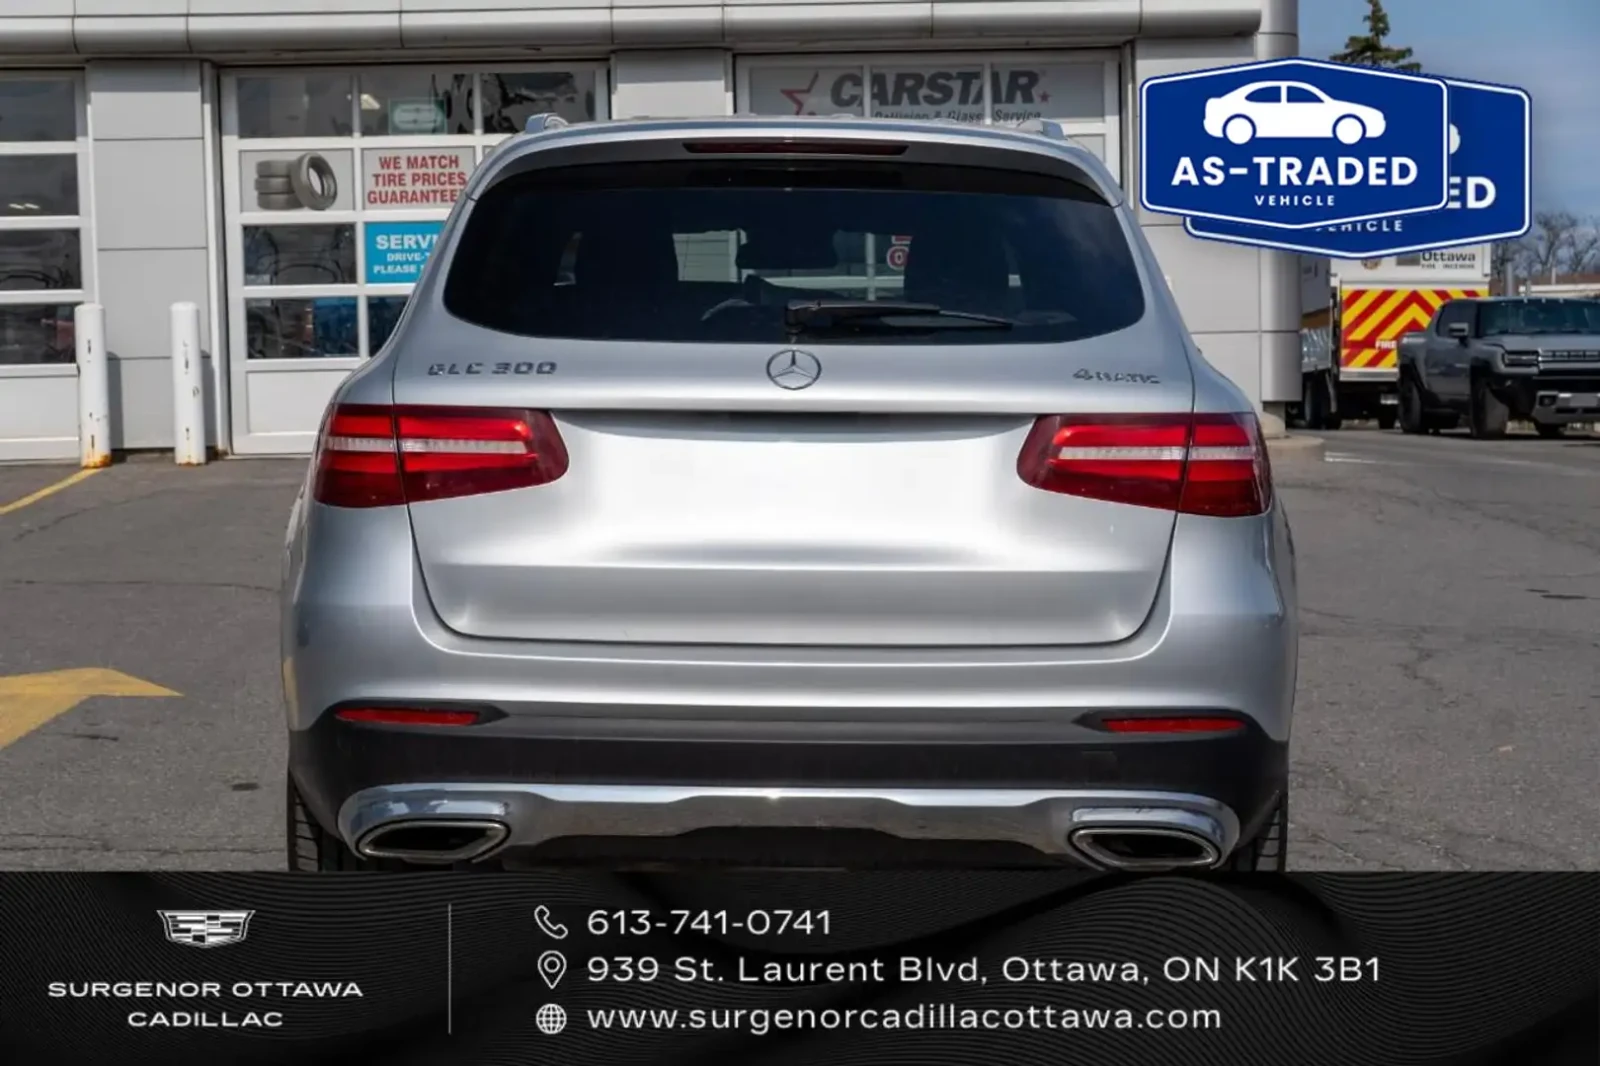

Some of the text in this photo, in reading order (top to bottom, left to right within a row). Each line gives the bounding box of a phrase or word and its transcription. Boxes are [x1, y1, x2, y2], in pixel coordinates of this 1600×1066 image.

[830, 70, 1041, 107] CARSTAR
[378, 154, 460, 170] WE MATCH
[372, 171, 467, 187] TIRE PRICES
[367, 189, 464, 204] GUARANTEE
[1421, 251, 1476, 262] Ottawa
[373, 264, 417, 274] PLEASE
[427, 361, 557, 376] GLC 300
